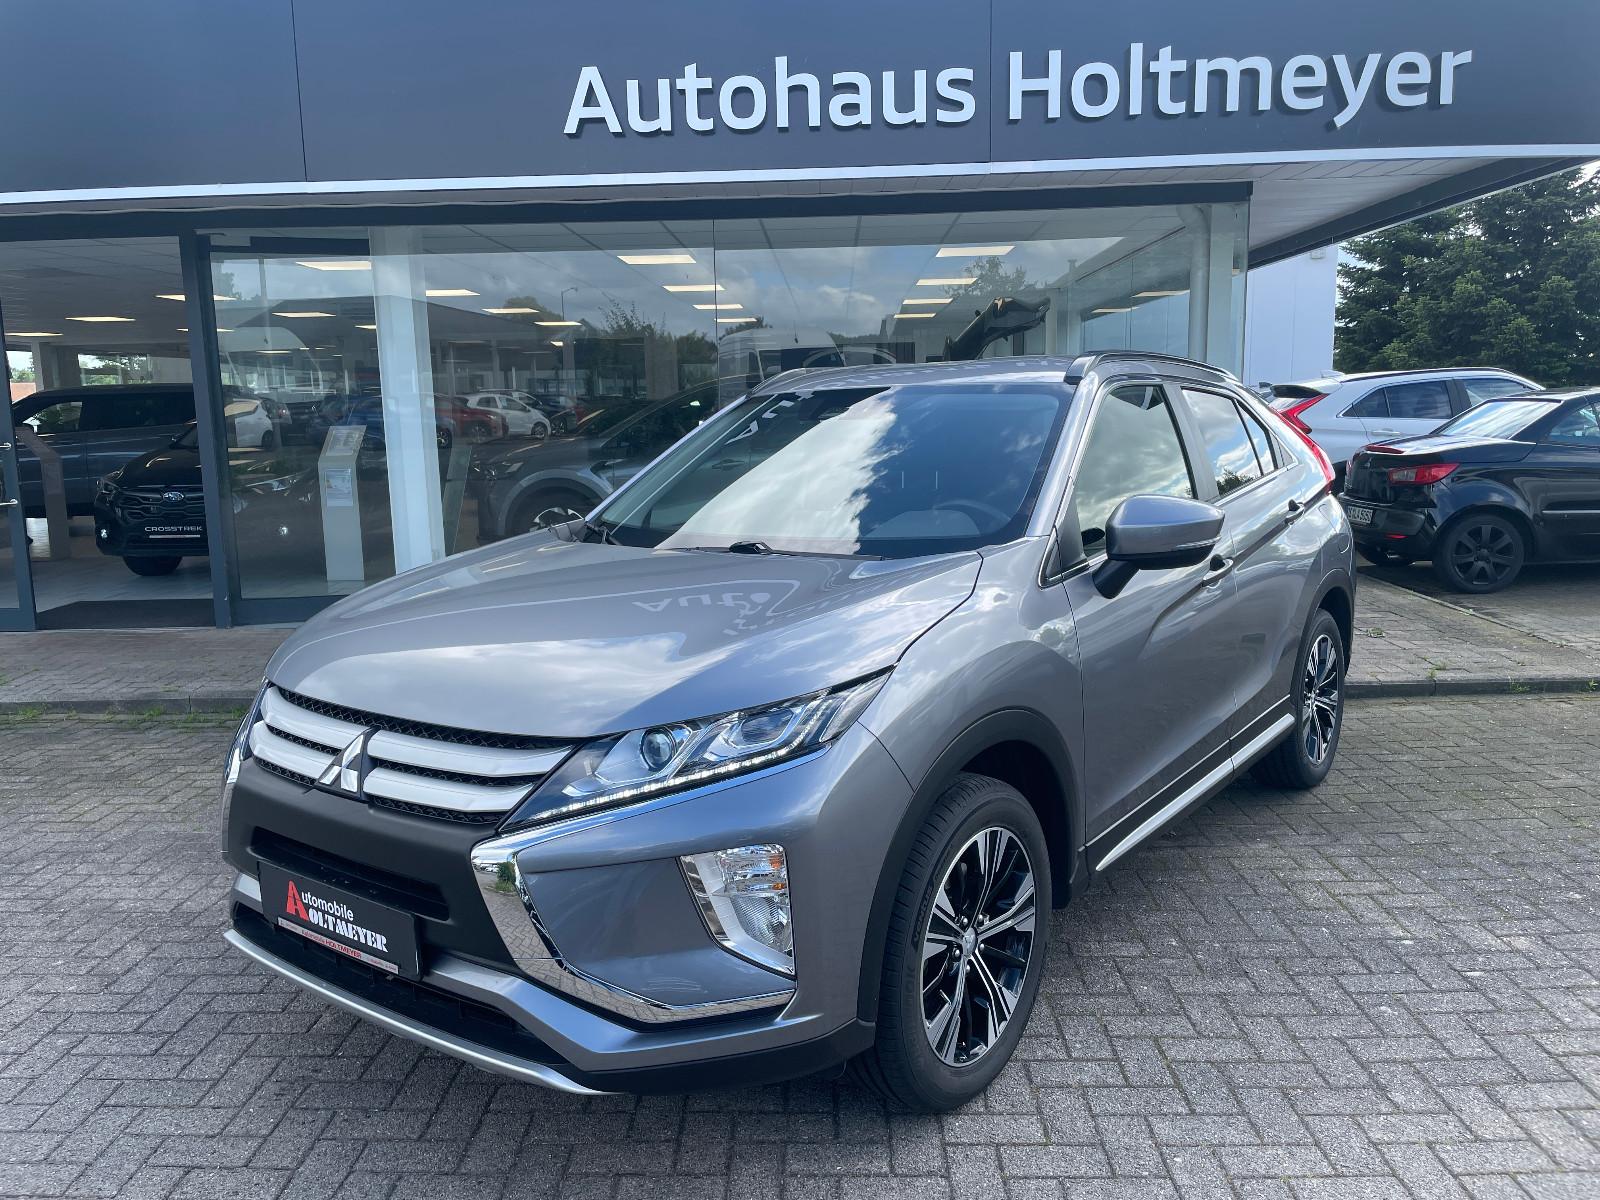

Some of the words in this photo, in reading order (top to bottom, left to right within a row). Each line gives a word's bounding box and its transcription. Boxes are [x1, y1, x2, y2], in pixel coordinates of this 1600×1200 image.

[563, 56, 976, 135] Autohaus
[1009, 42, 1473, 128] Holtmeyer
[286, 880, 354, 921] Automobile
